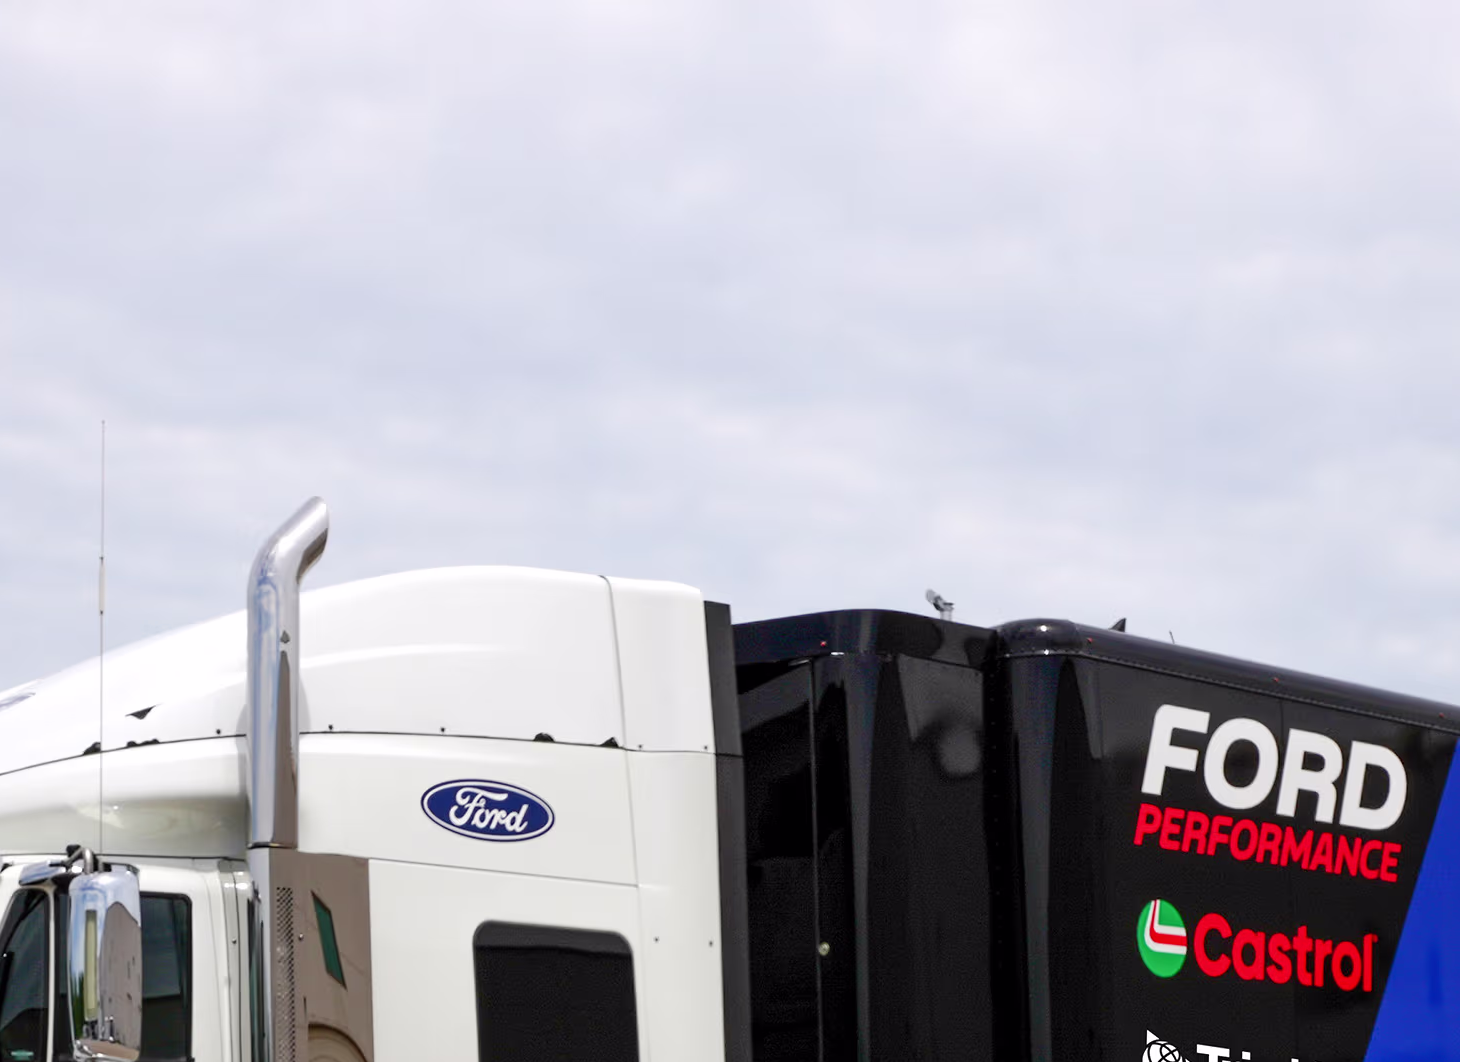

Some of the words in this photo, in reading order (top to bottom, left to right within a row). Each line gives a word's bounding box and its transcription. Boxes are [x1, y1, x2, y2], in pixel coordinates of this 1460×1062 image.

[1141, 704, 1407, 831] FORD
[449, 787, 529, 832] Ford
[1134, 803, 1402, 883] PERFORMANCE
[1193, 912, 1379, 992] Castrol
